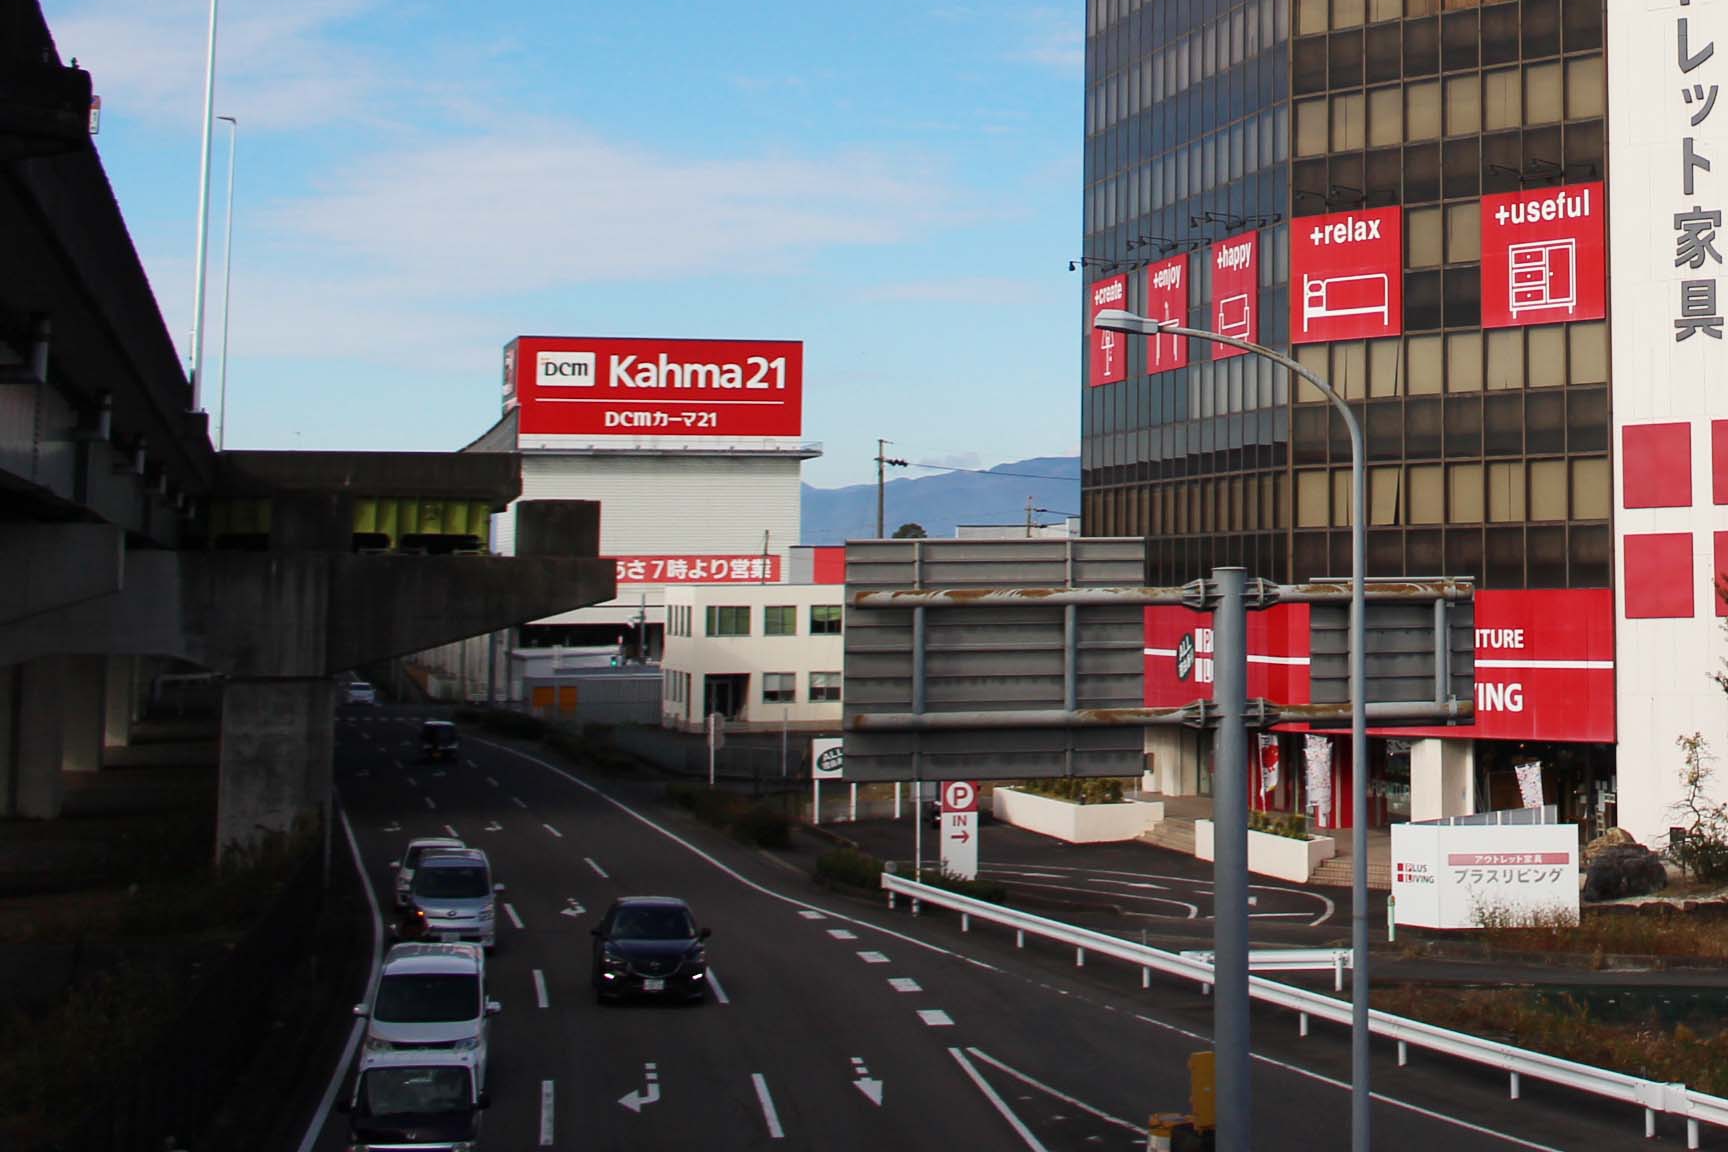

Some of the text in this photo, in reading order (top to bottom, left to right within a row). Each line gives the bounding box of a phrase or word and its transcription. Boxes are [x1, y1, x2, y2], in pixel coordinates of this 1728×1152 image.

[1475, 682, 1523, 712] ING
[953, 787, 968, 806] P
[953, 815, 967, 826] IN
[1454, 868, 1563, 884] プラスリビング
